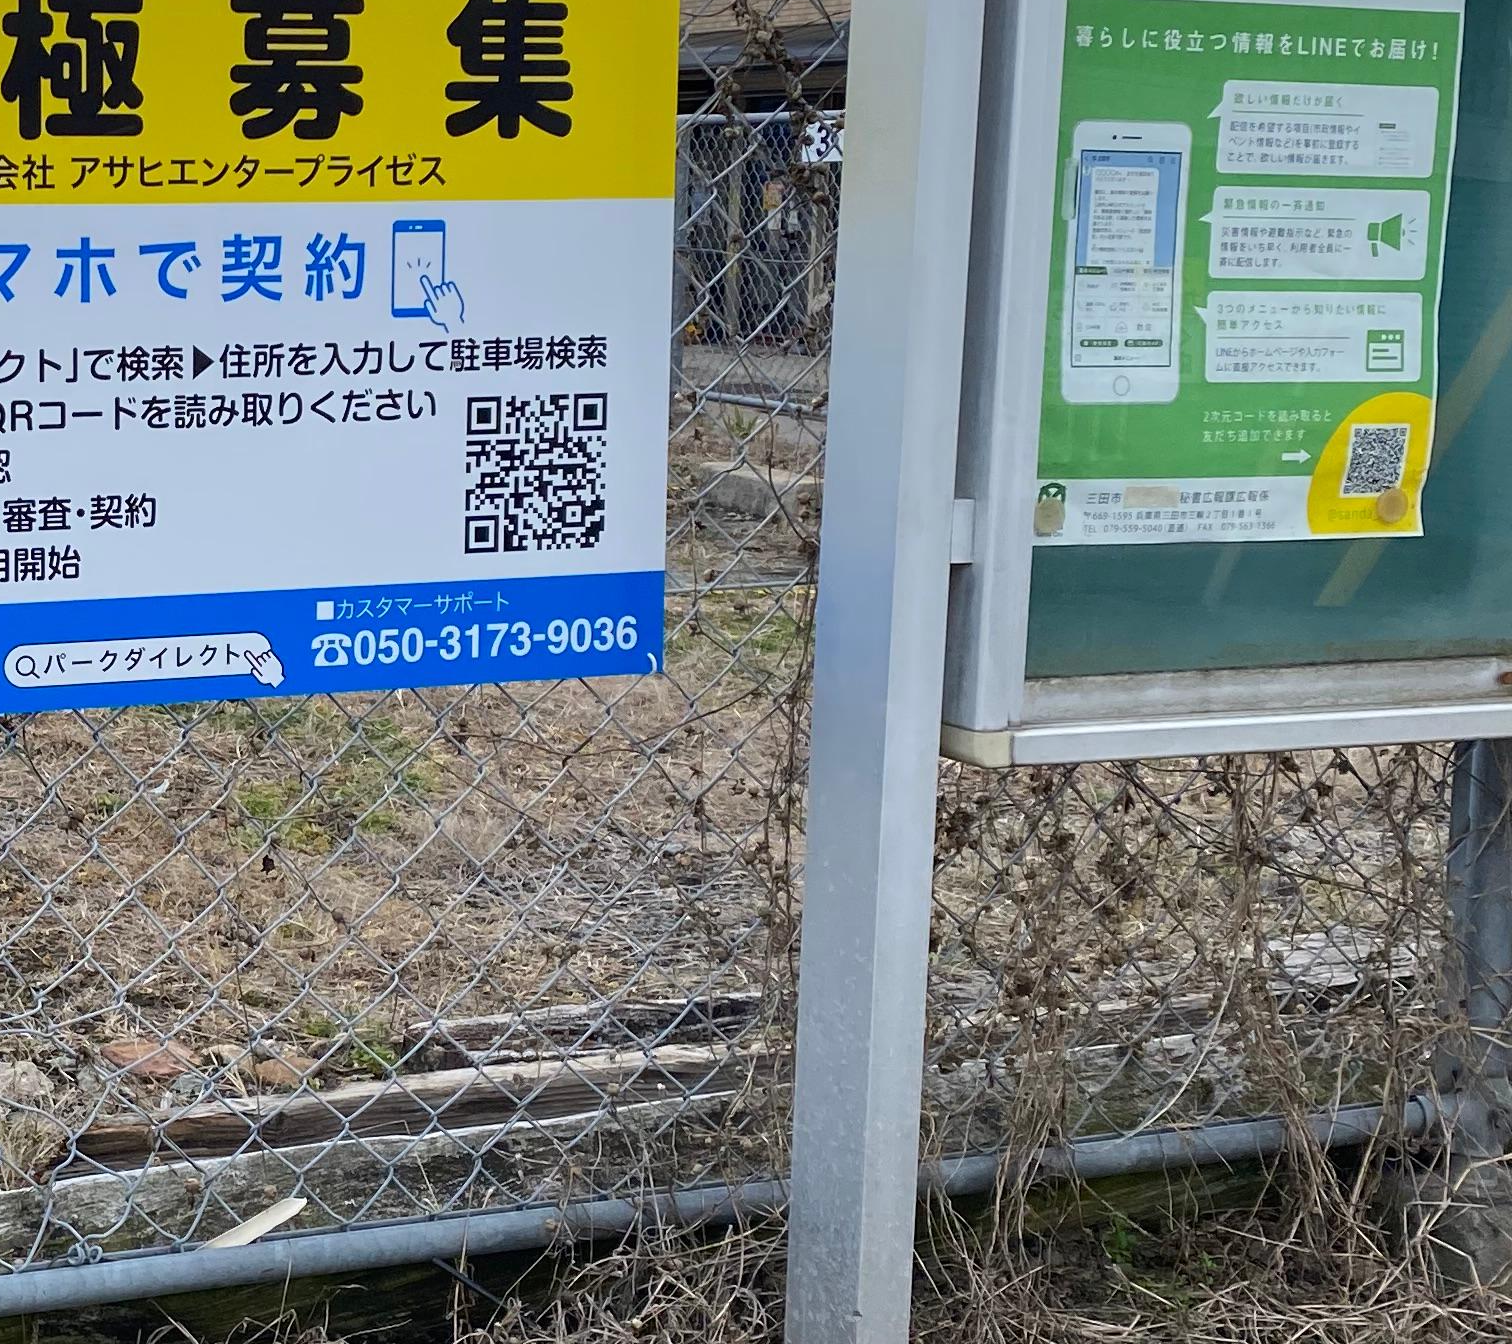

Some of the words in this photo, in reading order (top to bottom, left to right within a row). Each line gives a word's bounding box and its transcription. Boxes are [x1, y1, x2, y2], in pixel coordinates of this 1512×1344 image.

[70, 153, 448, 189] アサヒエンタープライゼス
[42, 640, 242, 675] パークダイレクト
[353, 615, 638, 666] 050-3173-9036
